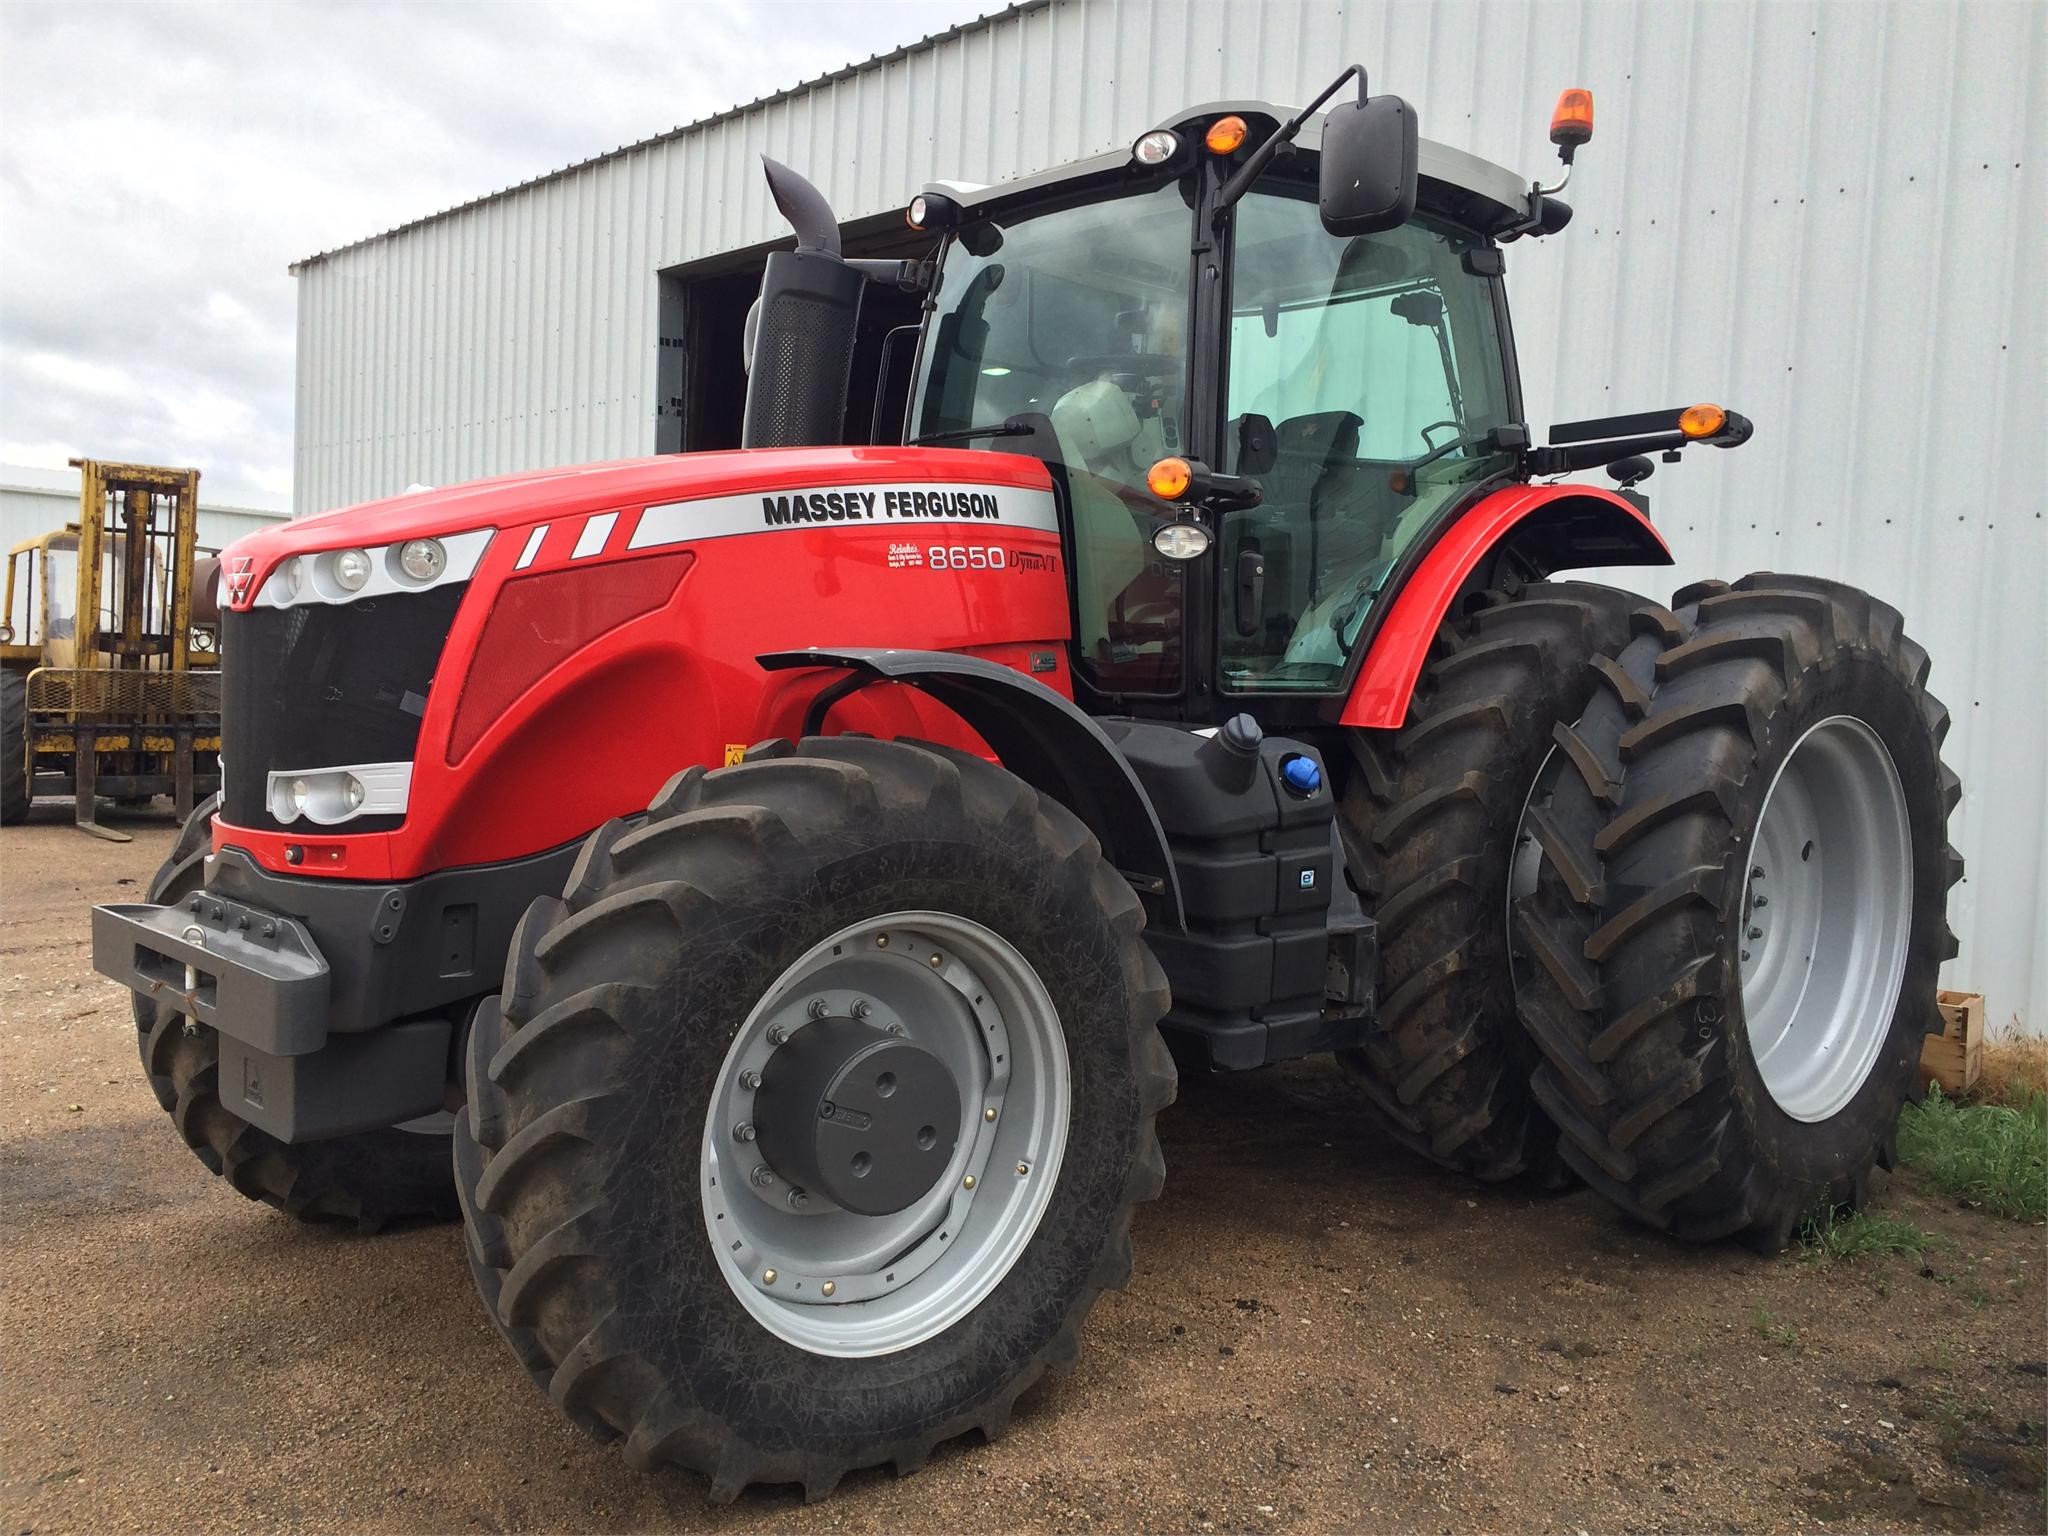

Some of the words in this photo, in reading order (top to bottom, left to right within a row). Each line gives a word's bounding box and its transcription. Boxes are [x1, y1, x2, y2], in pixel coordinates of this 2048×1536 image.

[762, 492, 876, 525] MASSEY
[884, 492, 999, 519] FERGUSON
[928, 545, 1006, 570] 8650
